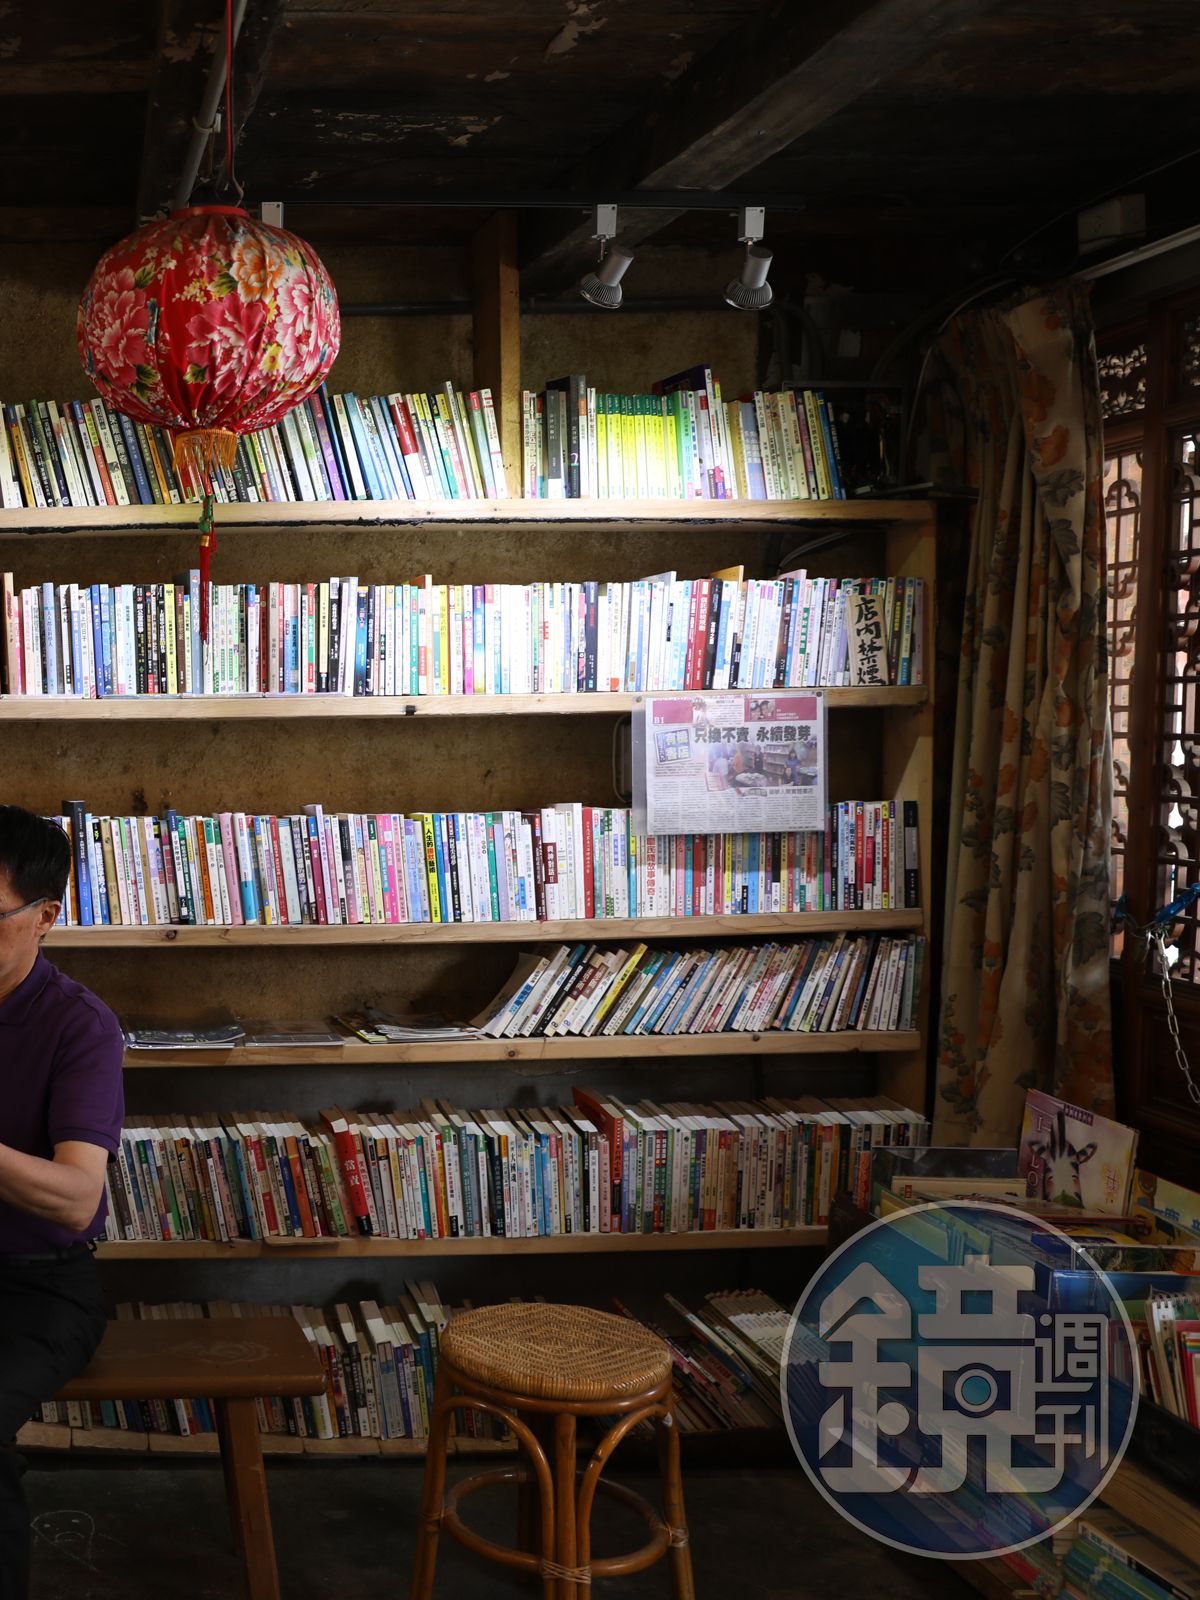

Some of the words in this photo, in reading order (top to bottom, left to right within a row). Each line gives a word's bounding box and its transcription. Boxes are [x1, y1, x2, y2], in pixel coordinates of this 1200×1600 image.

[694, 726, 750, 743] 只換不賣
[756, 725, 811, 743] 永續發芽
